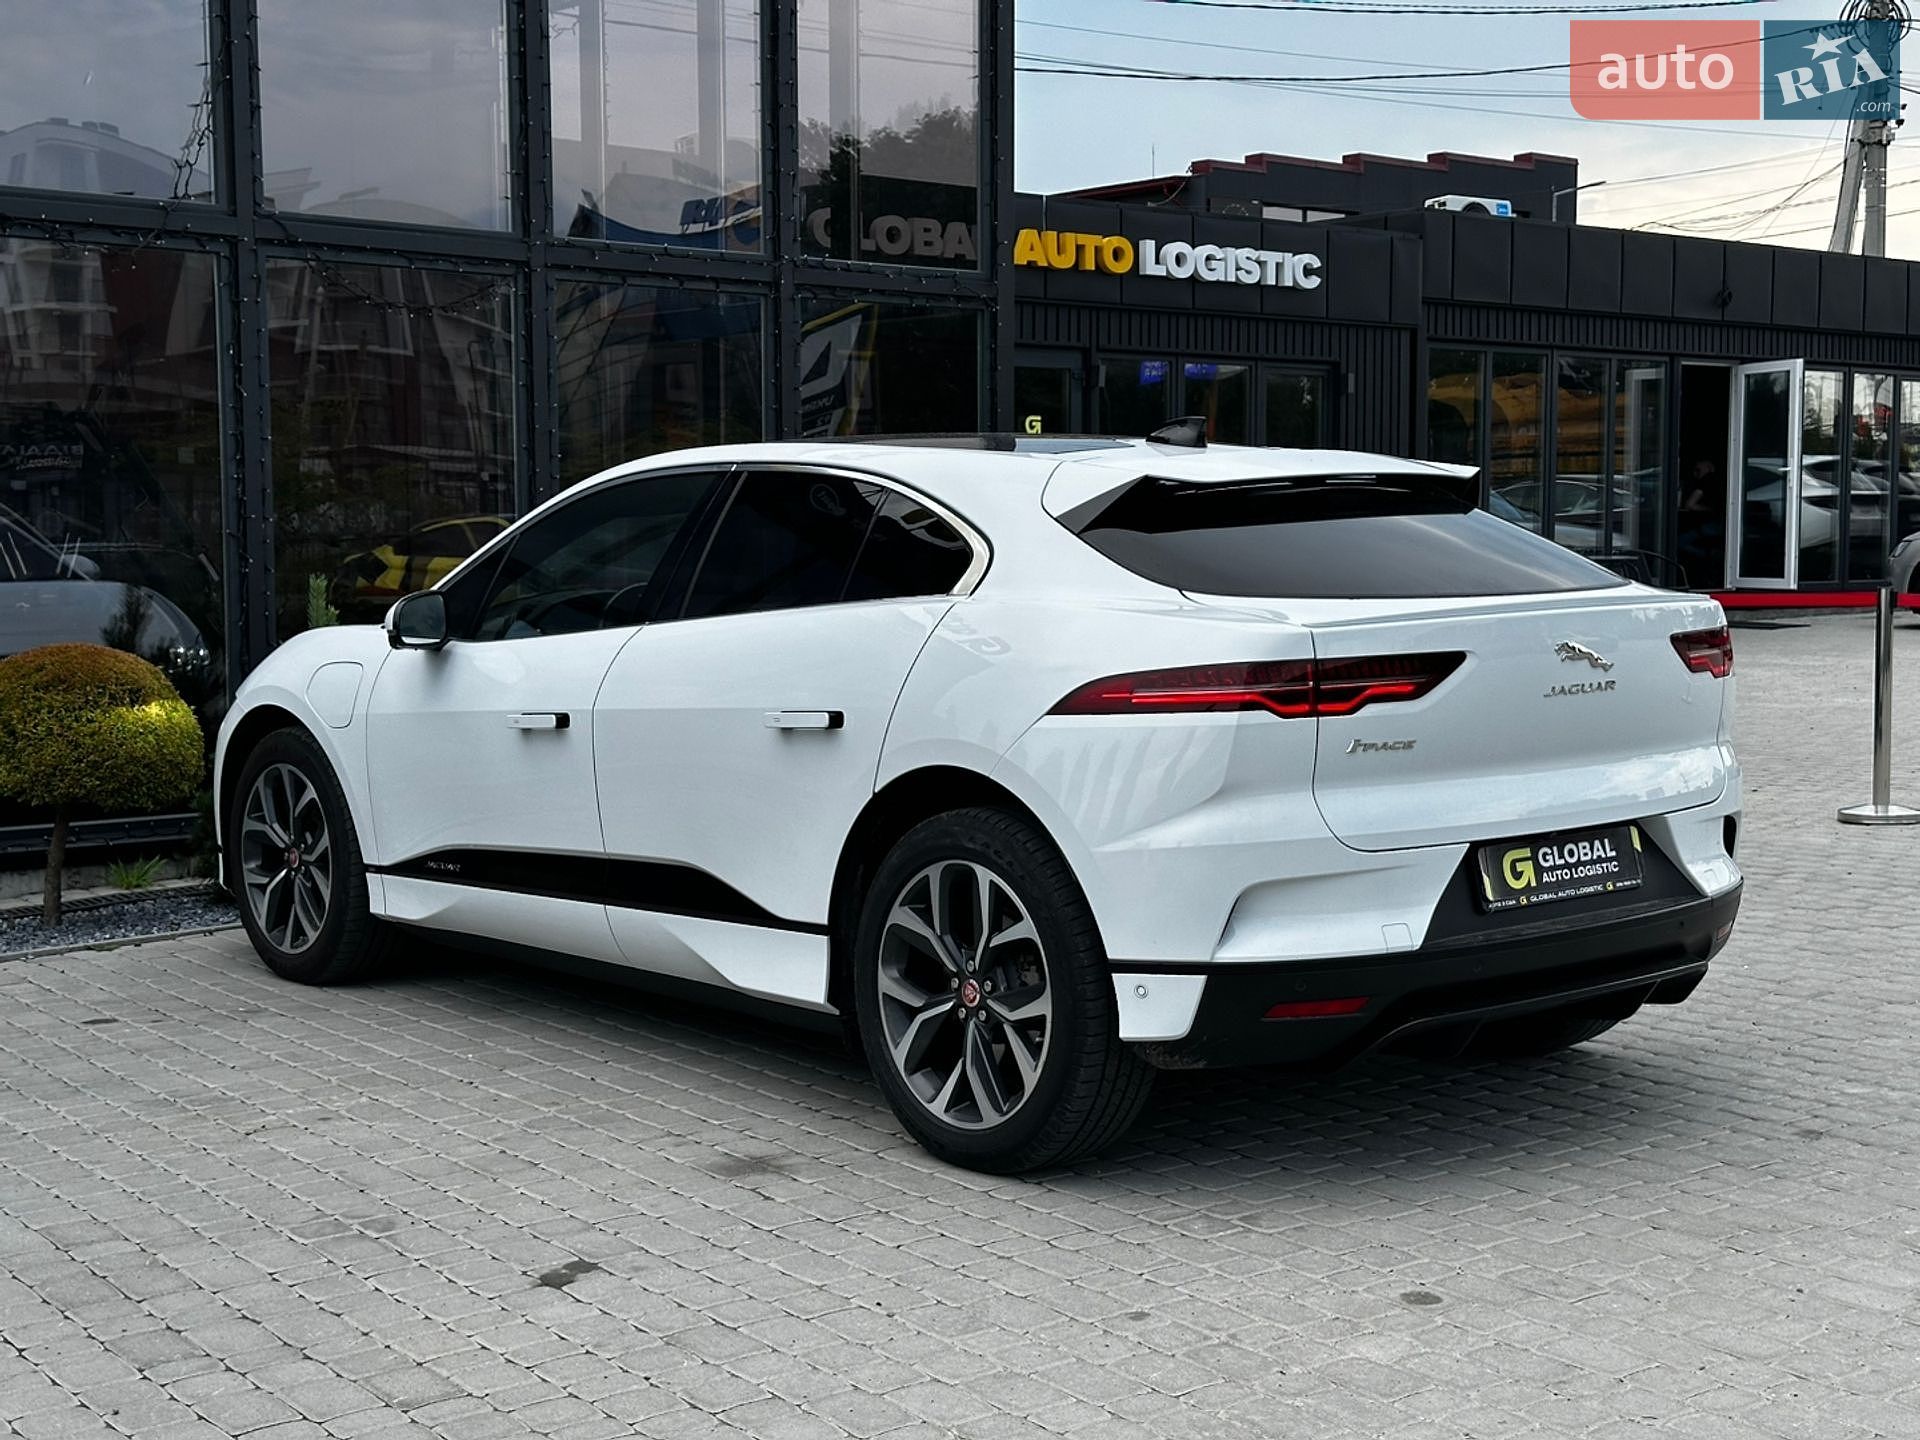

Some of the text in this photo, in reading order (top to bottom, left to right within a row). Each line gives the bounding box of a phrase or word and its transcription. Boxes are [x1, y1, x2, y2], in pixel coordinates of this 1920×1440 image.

[1013, 228, 1134, 274] AUTO
[1138, 238, 1323, 290] LOGISTIC
[1543, 679, 1617, 699] JAGUAR
[1538, 838, 1617, 867] GLOBAL
[1542, 862, 1620, 883] AUTO LOGISTIC
[1530, 892, 1557, 903] GLOBAL
[1558, 889, 1576, 898] AUTO
[1576, 884, 1604, 895] LOGISTIC
